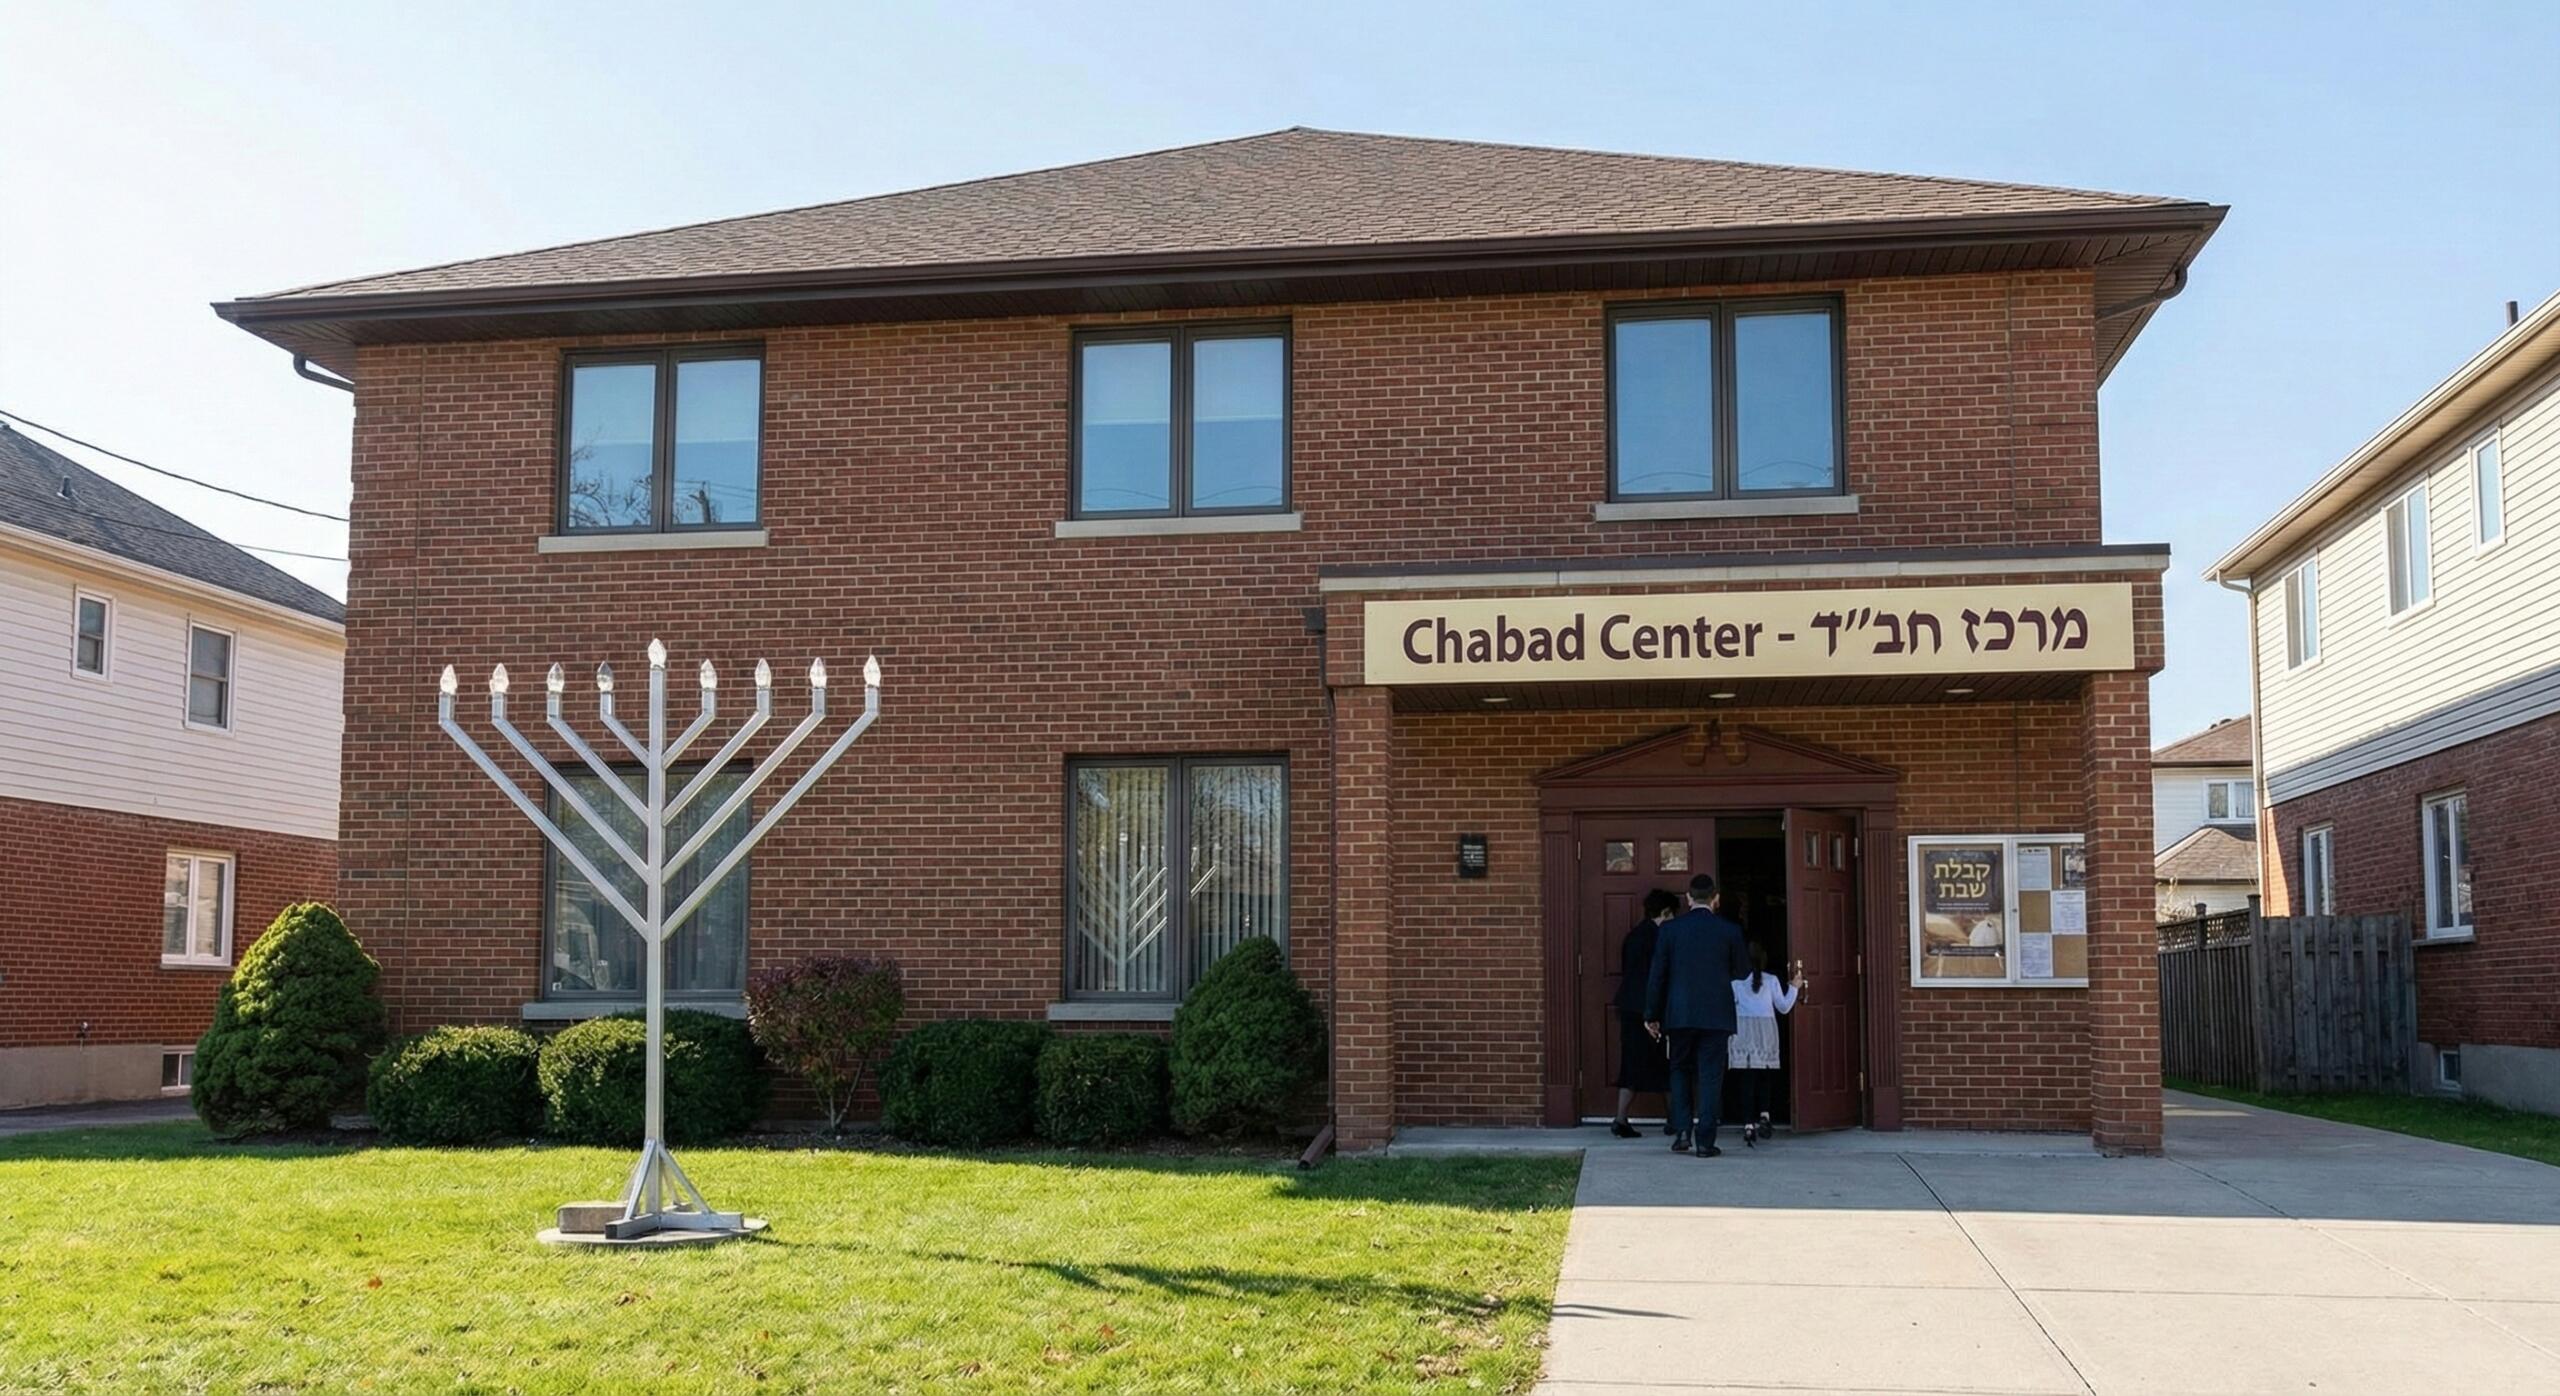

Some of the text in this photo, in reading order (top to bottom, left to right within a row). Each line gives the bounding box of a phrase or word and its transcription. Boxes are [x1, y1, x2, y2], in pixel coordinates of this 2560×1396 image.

[1402, 613, 1585, 665] Chabad
[1599, 614, 1763, 661] Center
[1960, 605, 2089, 654] מרכז
[1933, 858, 1991, 882] קבלת
[1938, 882, 1986, 898] שבת
